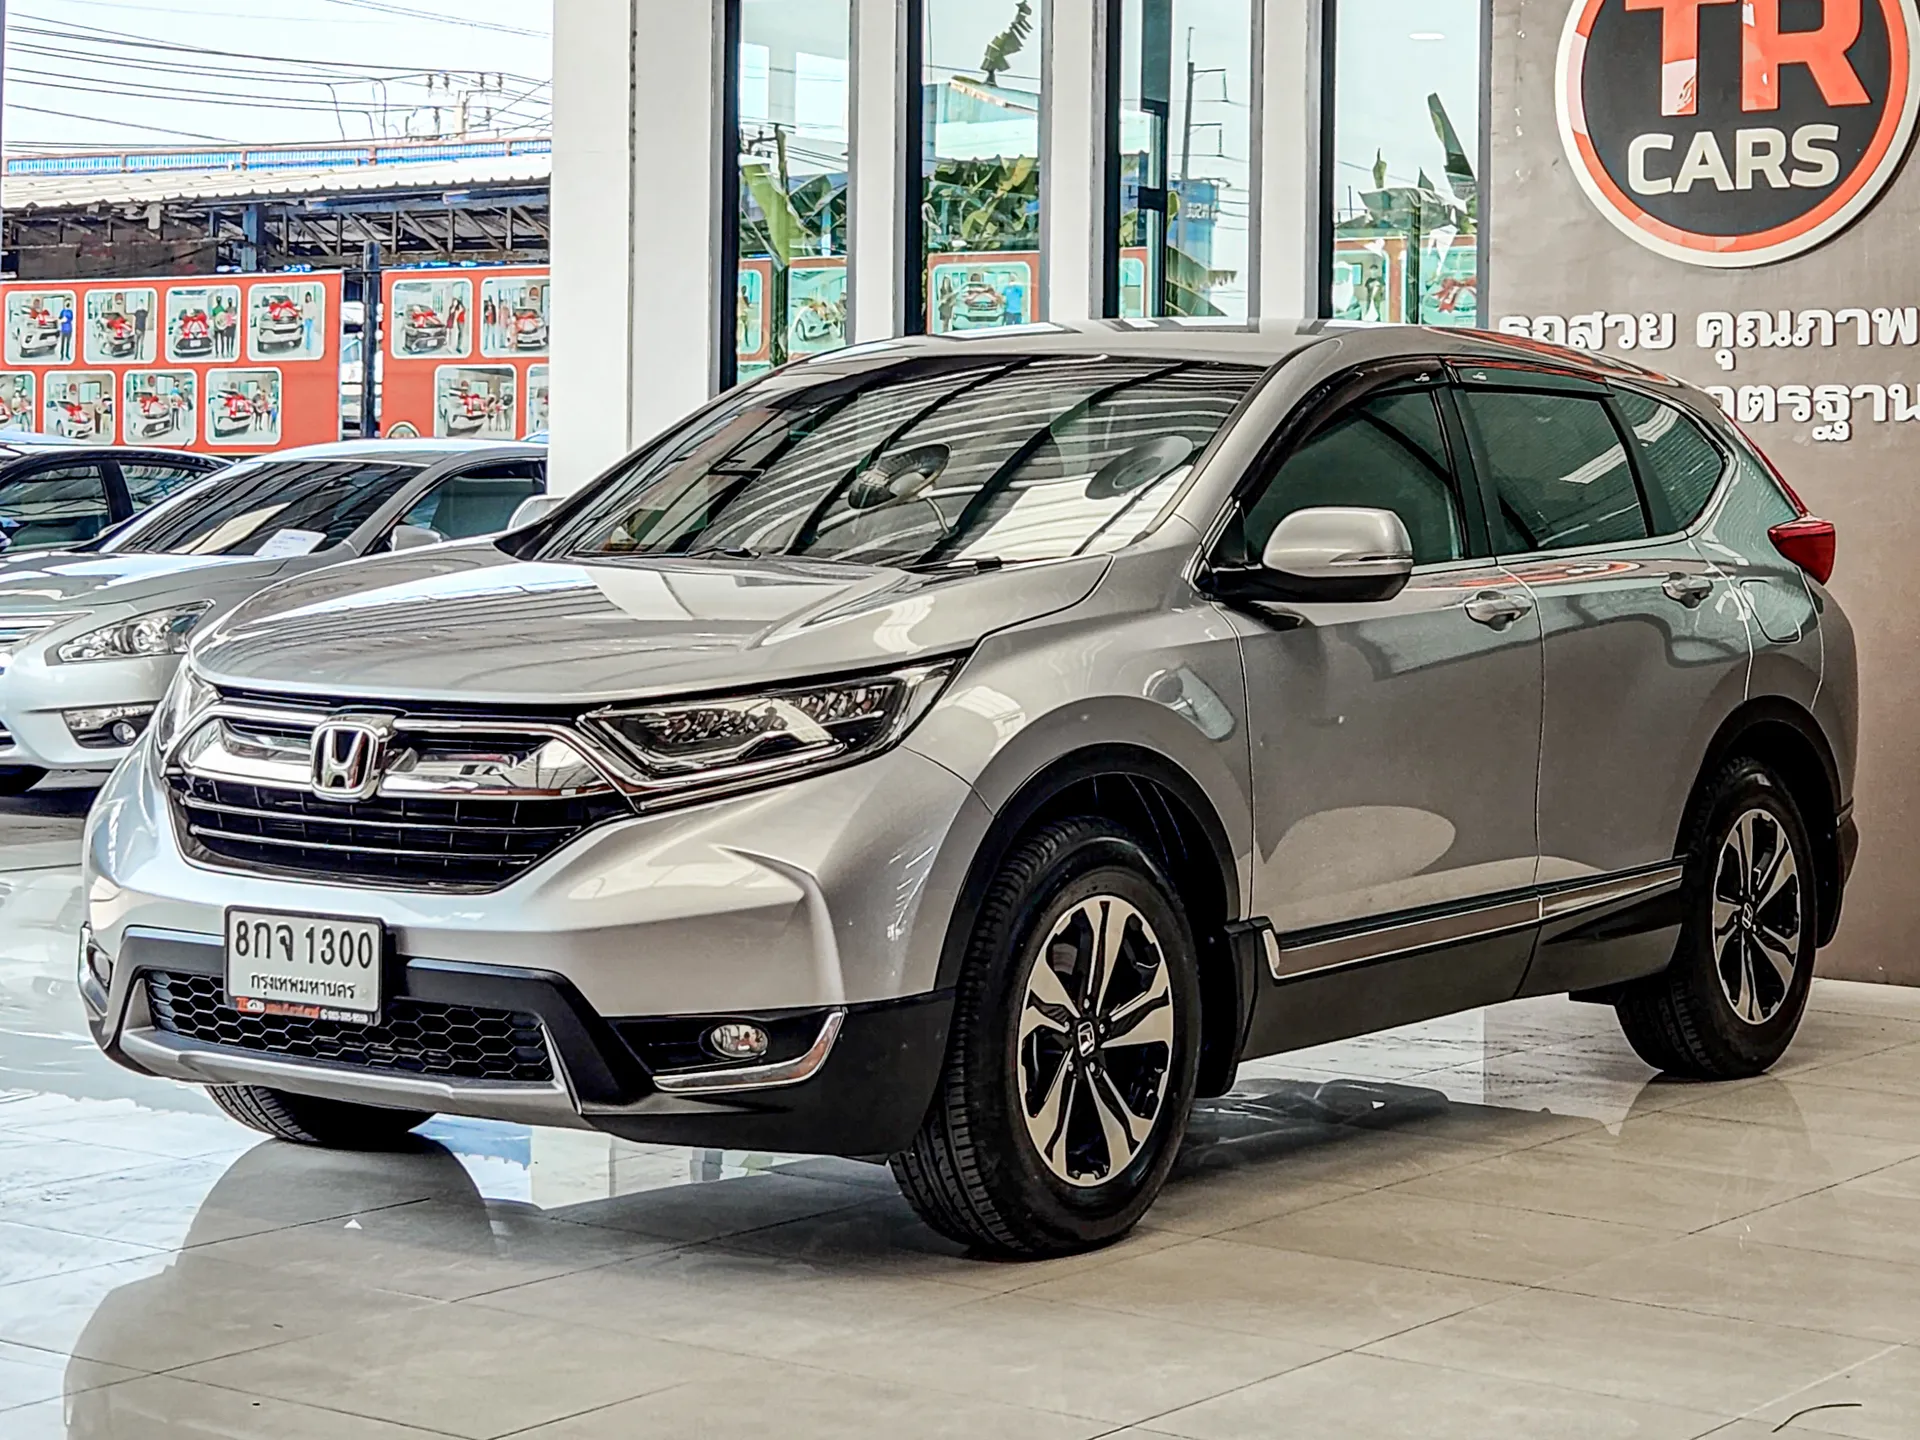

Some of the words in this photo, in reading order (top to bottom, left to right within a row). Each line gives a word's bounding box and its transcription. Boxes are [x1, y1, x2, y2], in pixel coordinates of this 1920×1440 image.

[1625, 0, 1871, 117] TR
[1628, 124, 1840, 195] CARS
[1696, 307, 1918, 371] คุณภาพ
[235, 920, 294, 962] 8กจ
[305, 926, 373, 969] 1300
[251, 972, 356, 999] กรุงเทพมหานคร
